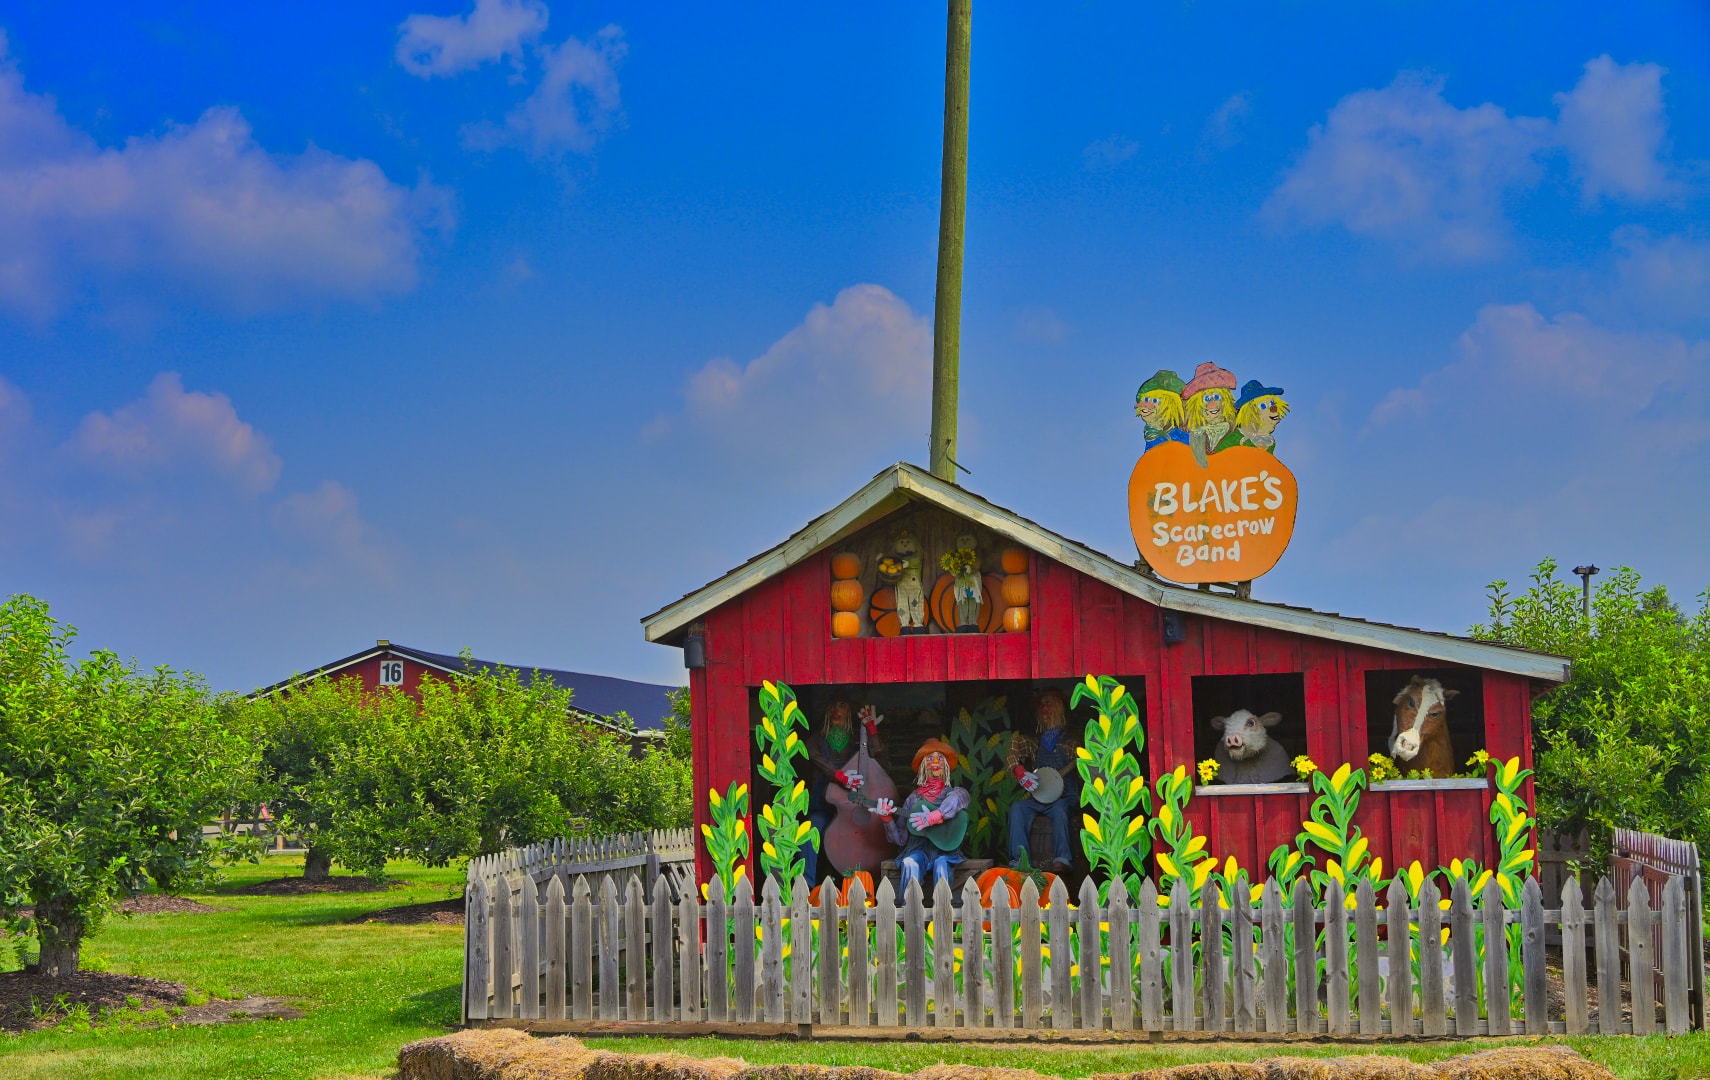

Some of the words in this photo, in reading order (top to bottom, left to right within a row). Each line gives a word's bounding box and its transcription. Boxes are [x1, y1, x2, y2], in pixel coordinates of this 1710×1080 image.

[1154, 470, 1284, 515] BLAKE'S
[1152, 516, 1275, 546] Scarecrow
[1176, 540, 1240, 567] Band
[382, 663, 401, 682] 16
